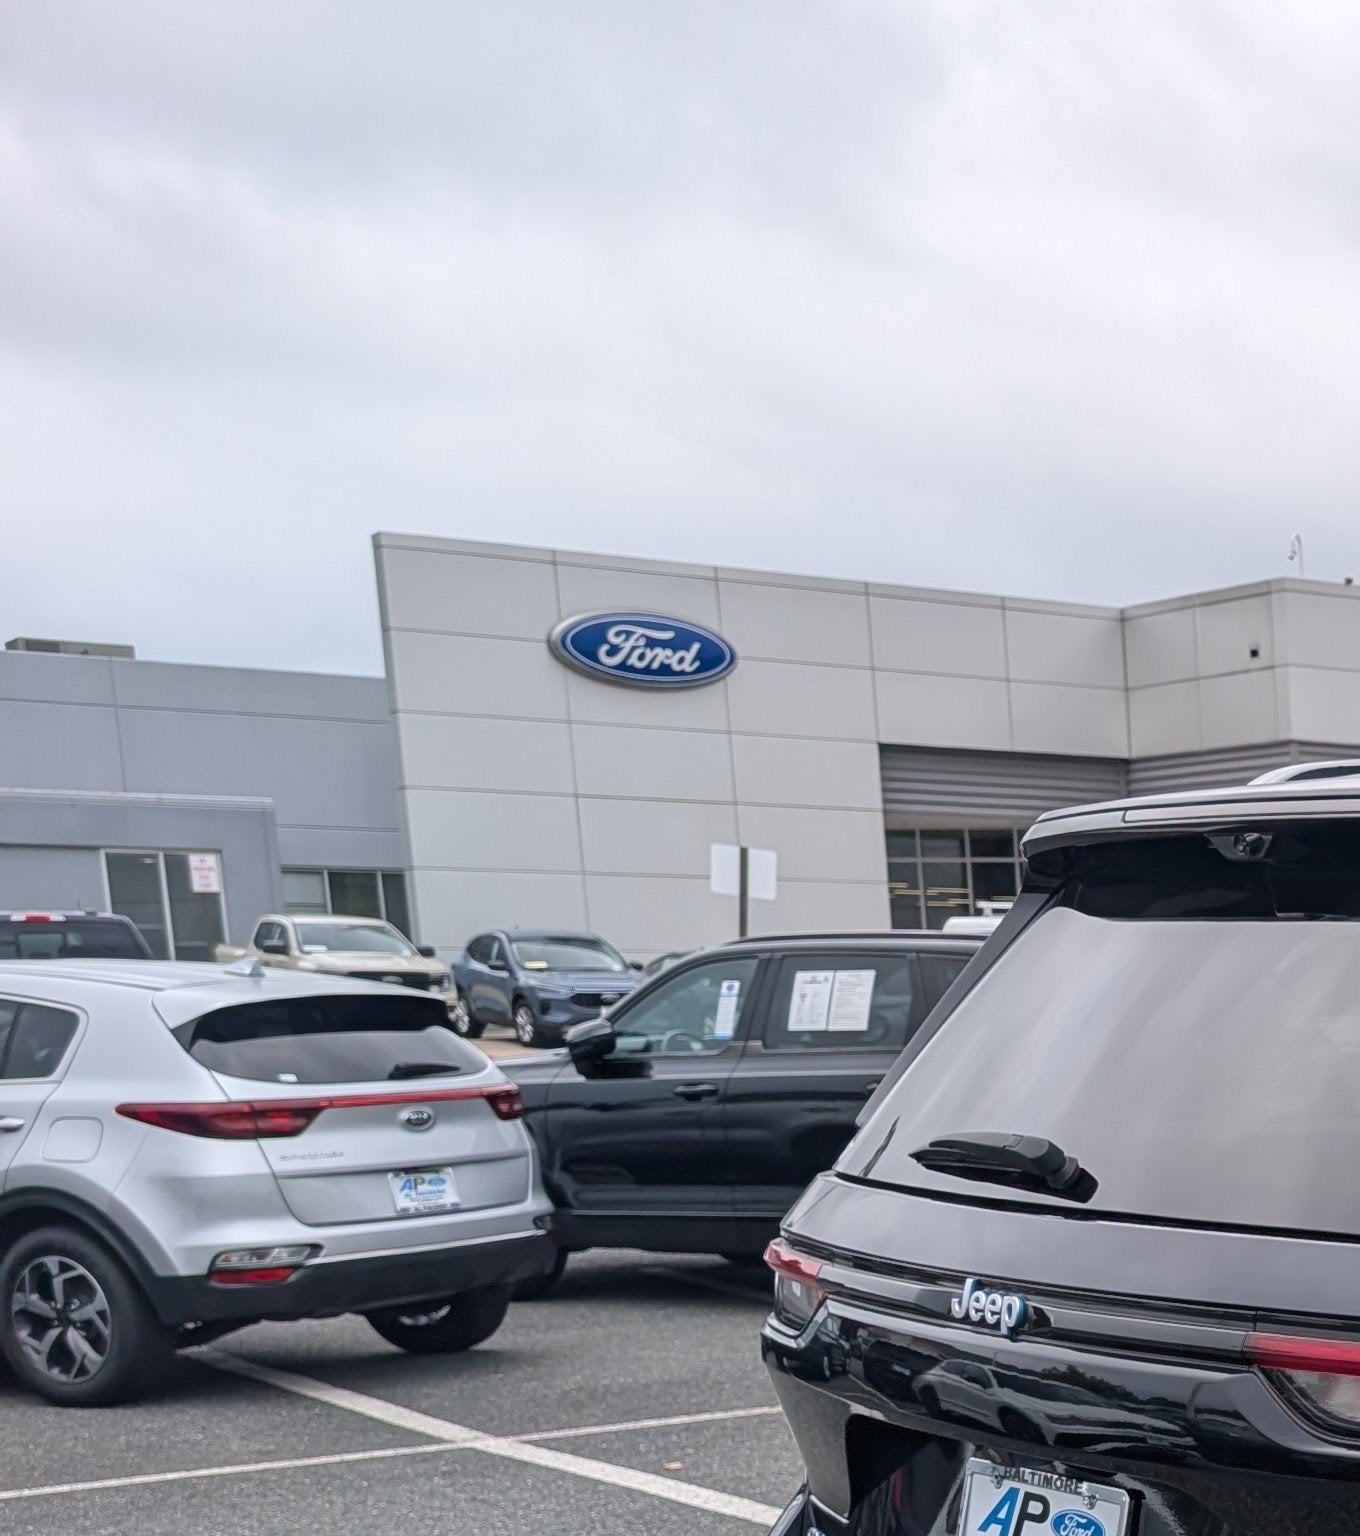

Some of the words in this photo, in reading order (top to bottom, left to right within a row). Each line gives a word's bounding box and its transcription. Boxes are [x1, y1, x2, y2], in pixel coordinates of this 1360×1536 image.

[598, 624, 702, 673] Ford
[951, 1277, 1025, 1338] Jeep
[1003, 1466, 1083, 1495] BALTIMORE
